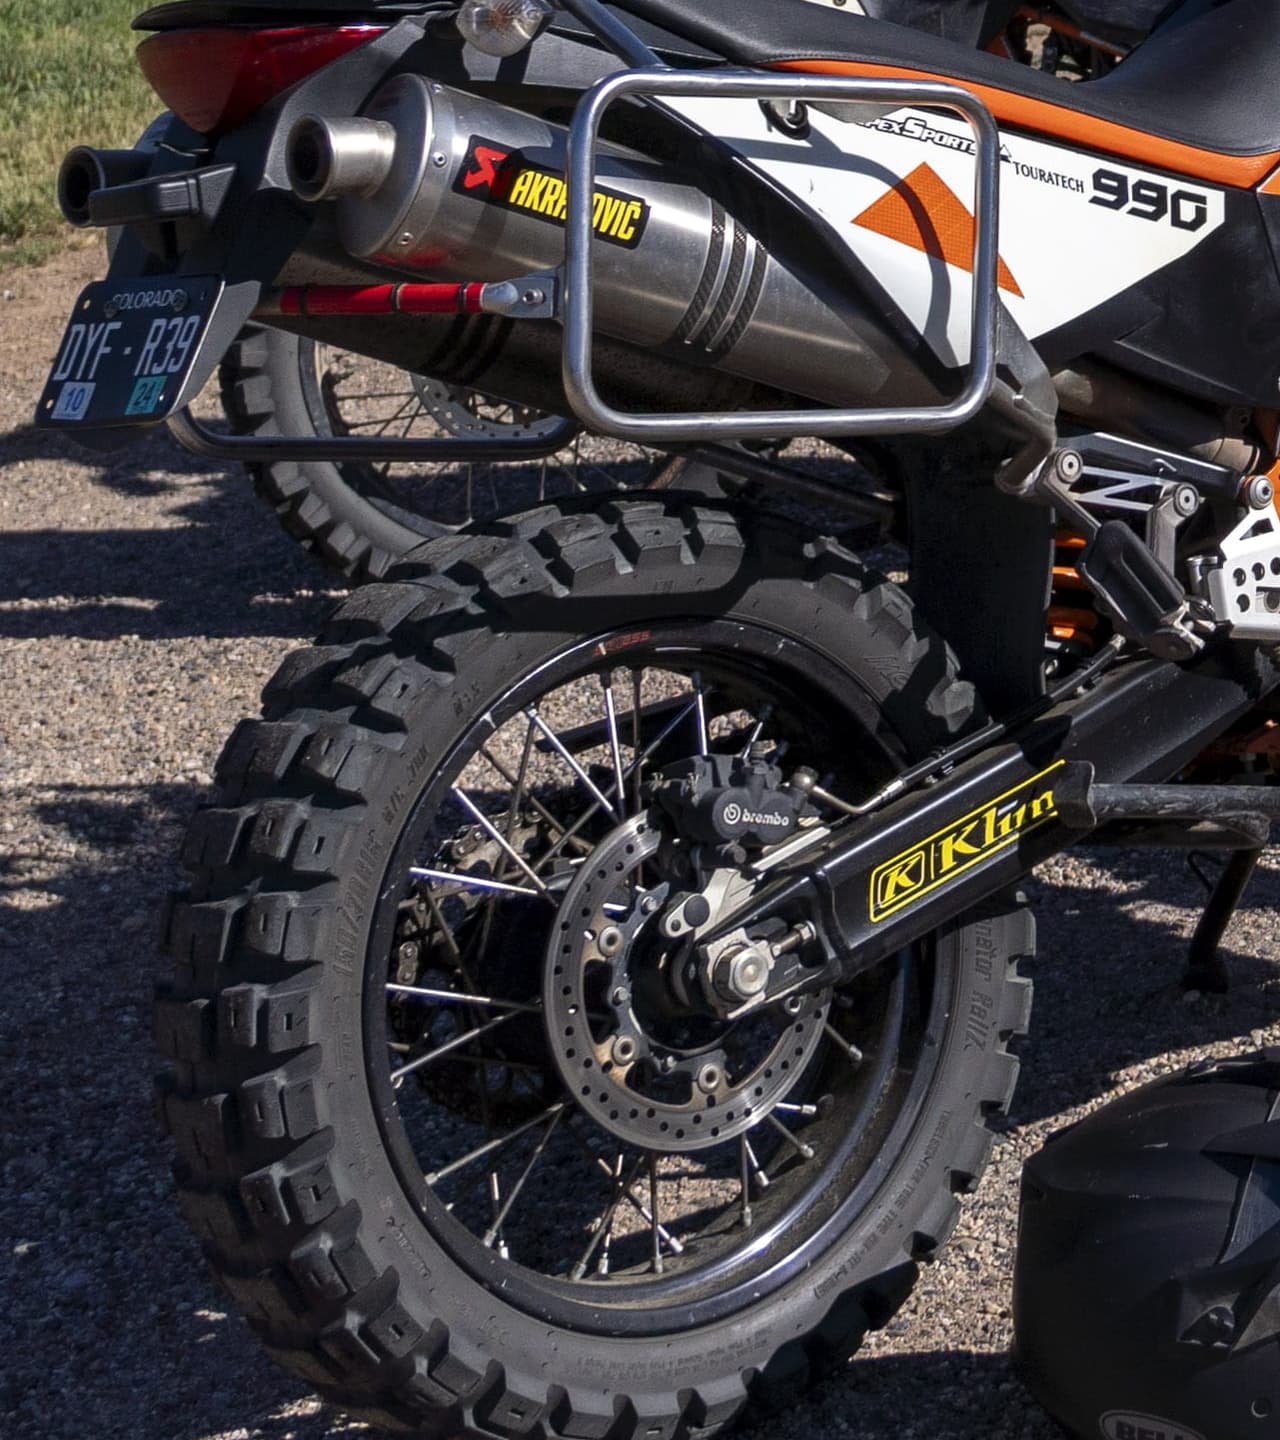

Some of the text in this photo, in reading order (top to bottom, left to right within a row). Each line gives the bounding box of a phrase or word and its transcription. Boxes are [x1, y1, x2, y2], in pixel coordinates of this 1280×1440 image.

[1013, 161, 1084, 194] TOURATECH
[1089, 167, 1208, 232] 990
[112, 288, 186, 310] COLORADO
[52, 315, 200, 381] DYF R39
[65, 387, 86, 412] 10
[742, 807, 790, 827] brembo
[883, 854, 924, 902] K
